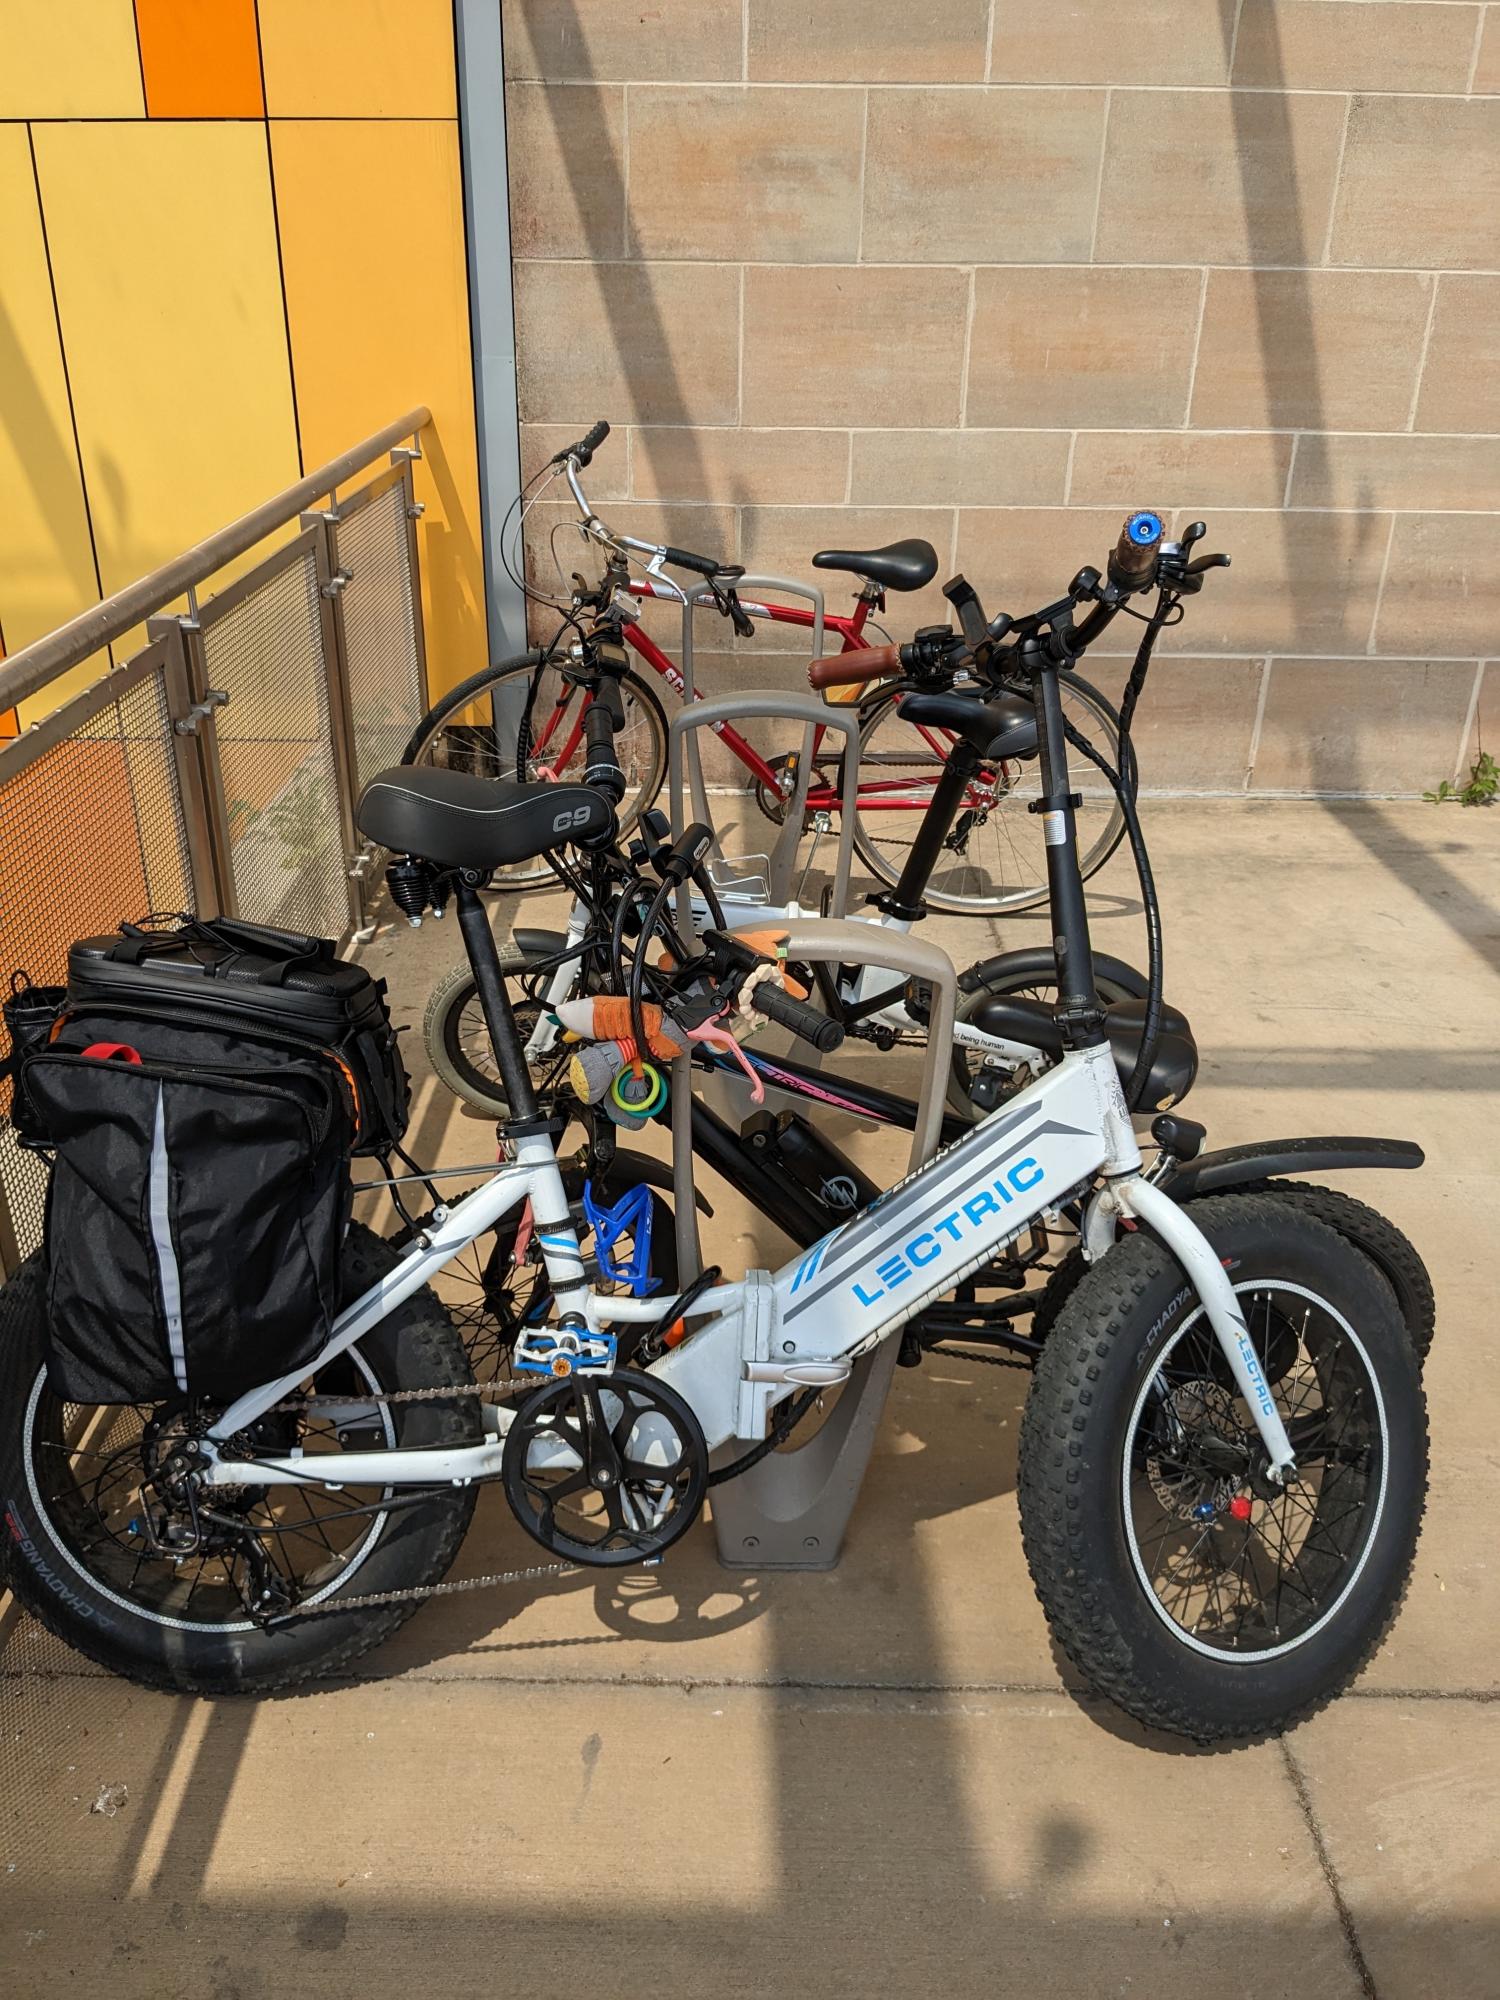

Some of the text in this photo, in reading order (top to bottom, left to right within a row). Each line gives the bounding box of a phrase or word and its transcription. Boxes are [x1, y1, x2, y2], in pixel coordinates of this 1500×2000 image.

[960, 1033, 980, 1045] being
[980, 1039, 1005, 1051] human
[851, 1157, 1045, 1307] LECTRIC
[1145, 1285, 1193, 1347] CHAOYA
[1238, 1337, 1275, 1417] LECTRIC
[20, 1539, 96, 1619] CHAOYANG
